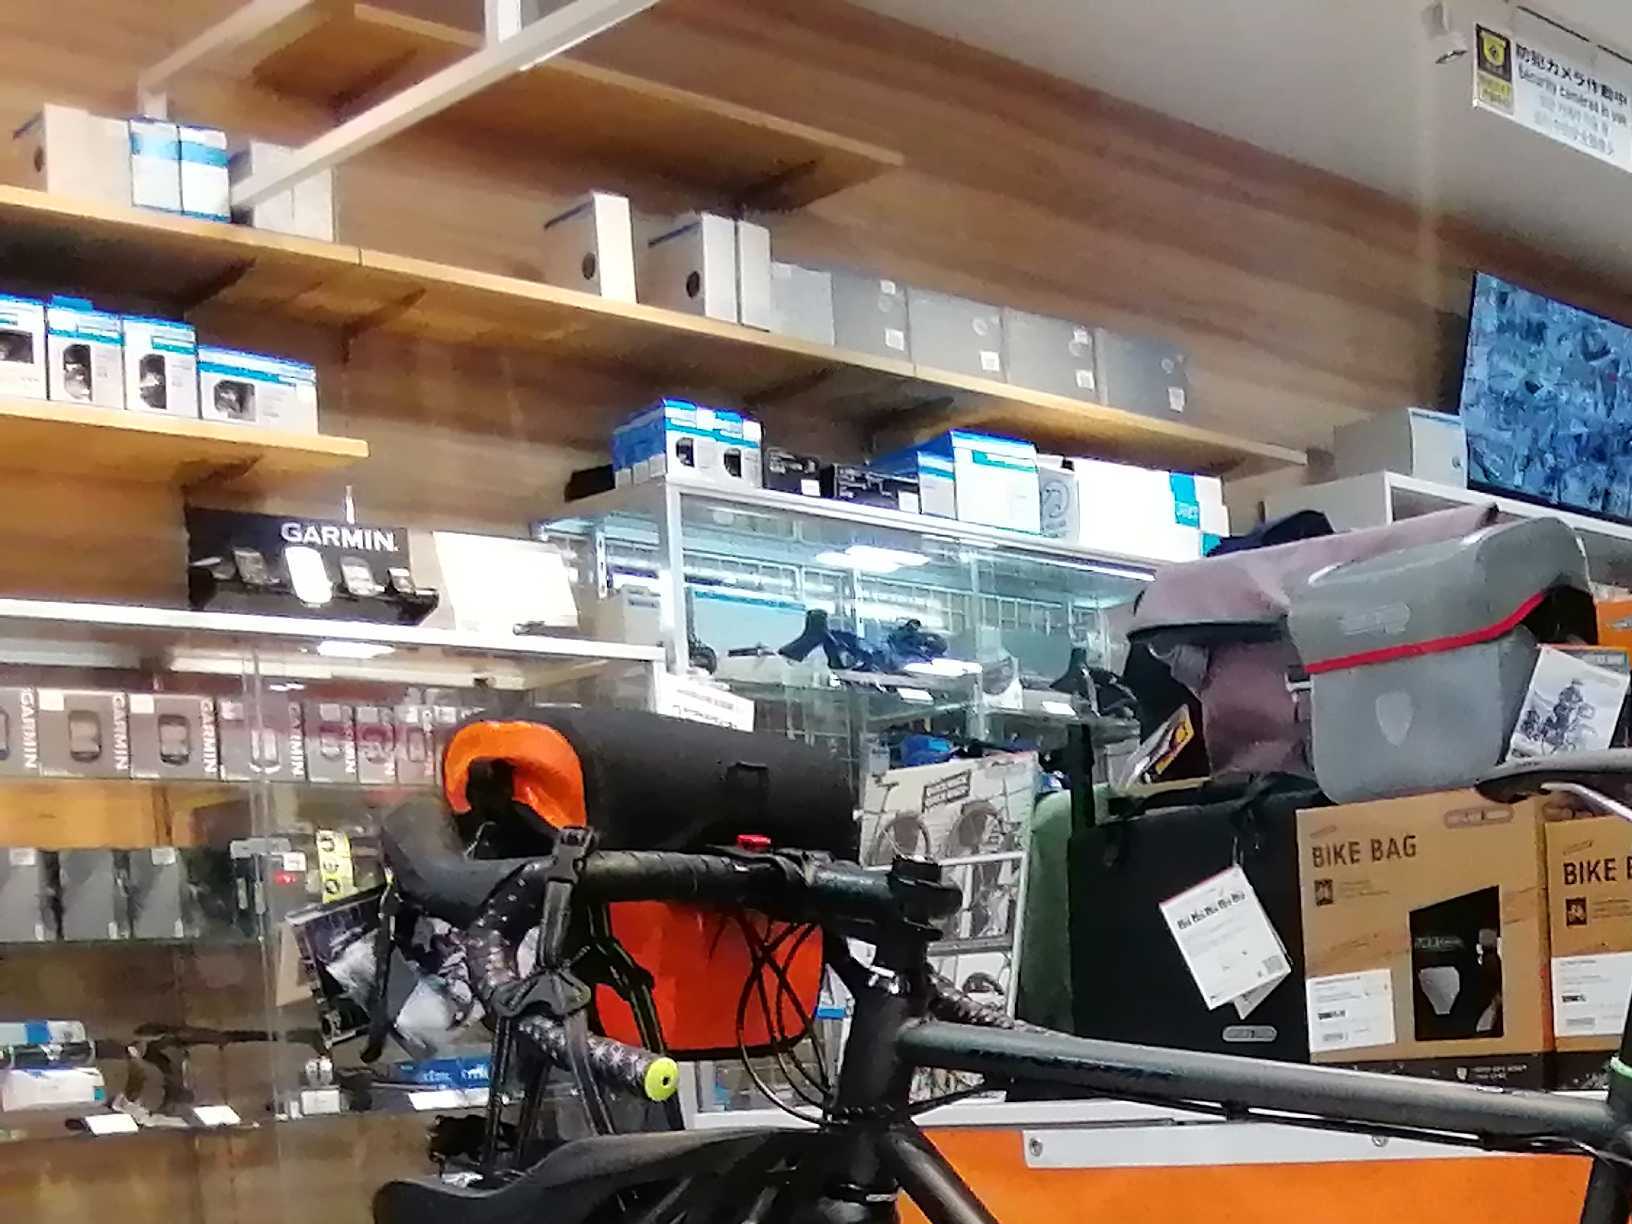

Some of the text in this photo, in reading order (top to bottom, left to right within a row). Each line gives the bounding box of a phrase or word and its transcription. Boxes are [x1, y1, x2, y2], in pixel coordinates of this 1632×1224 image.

[21, 691, 38, 771] GARMIN
[112, 694, 129, 772] GARMIN
[200, 700, 219, 774] GARMIN
[1312, 835, 1417, 868] BIKE BAG
[1563, 858, 1616, 885] BIKE
